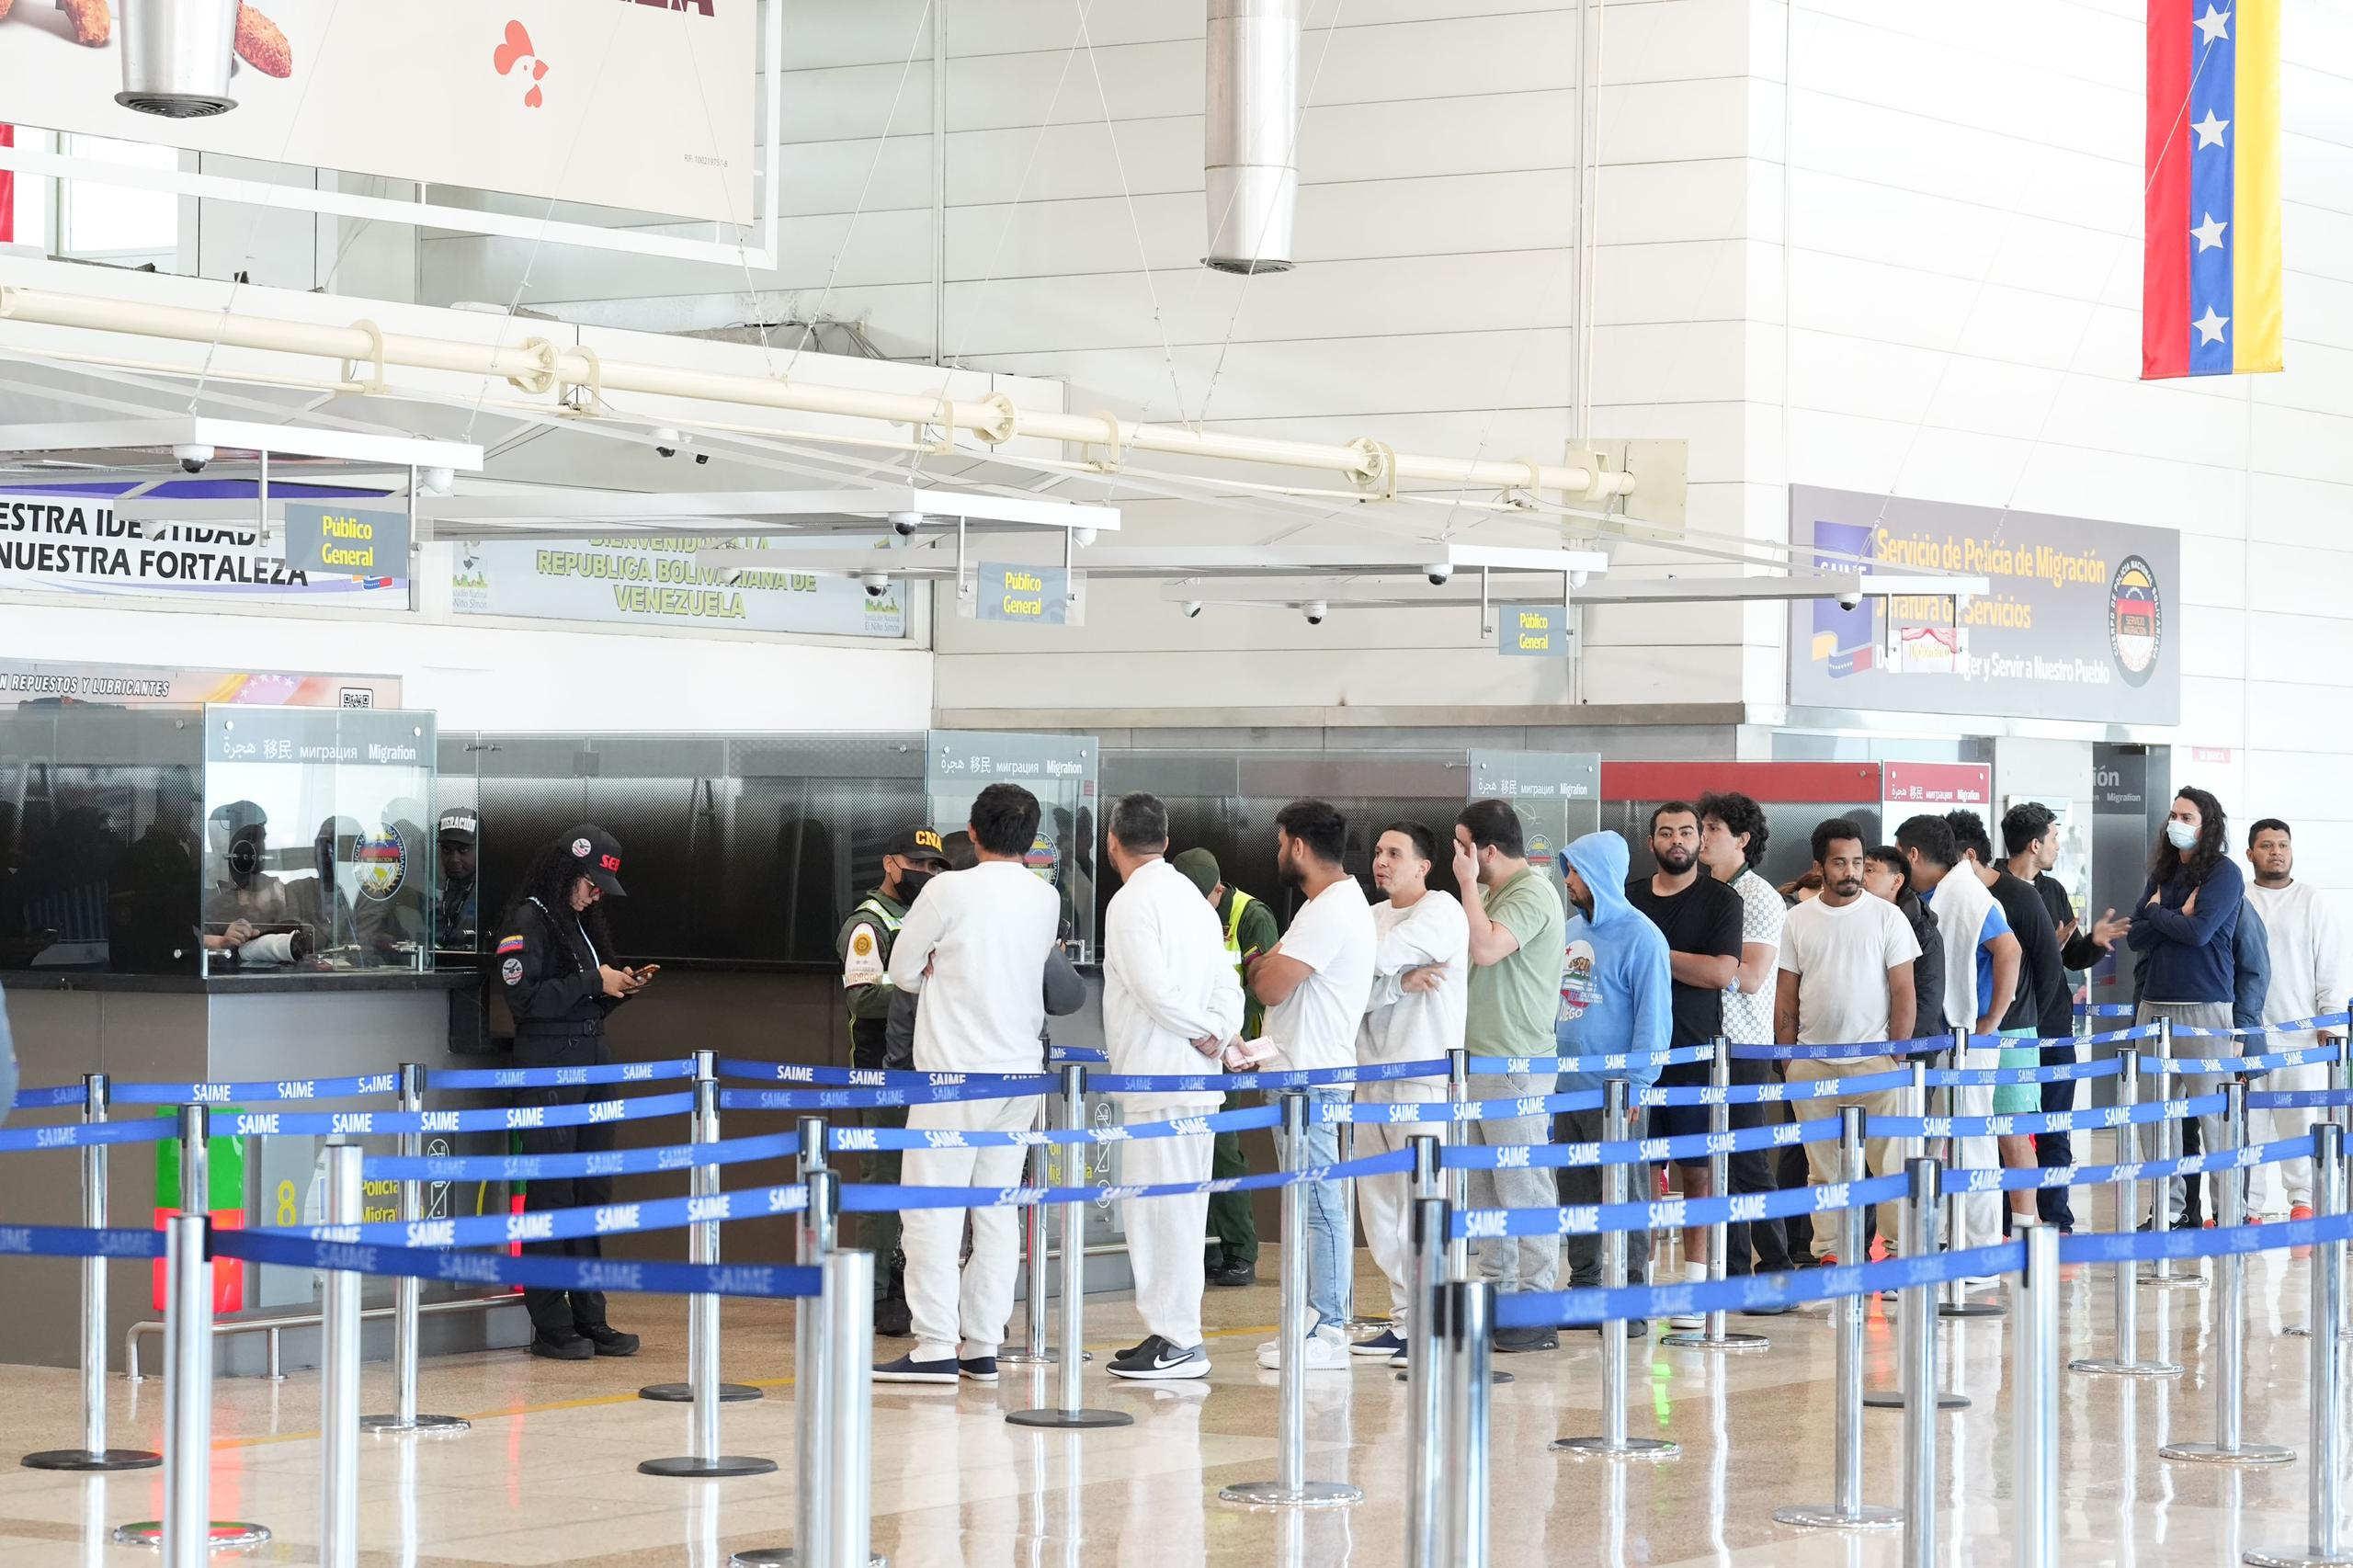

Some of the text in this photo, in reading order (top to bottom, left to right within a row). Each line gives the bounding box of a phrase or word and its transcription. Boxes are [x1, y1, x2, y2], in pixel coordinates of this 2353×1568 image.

[323, 515, 372, 540] Público
[322, 542, 373, 566] General
[1877, 528, 1939, 568] Servicio
[1942, 536, 1961, 571] de
[2015, 544, 2033, 577] de
[2036, 546, 2107, 588] Migración
[140, 550, 308, 586] FORTALEZA
[537, 550, 652, 582] REPUBLICA
[1005, 572, 1041, 591] Público
[614, 585, 745, 619] VENEZUELA
[1003, 595, 1041, 615] General
[1964, 596, 2031, 629] Servicios
[1519, 612, 1548, 629] Público
[1519, 632, 1549, 649] General
[1984, 656, 1992, 682] y
[1992, 652, 2024, 677] Servir
[2026, 660, 2033, 678] a
[2034, 655, 2074, 682] Nuestro
[2075, 658, 2110, 684] Pueblo
[11, 674, 77, 693] REPUESTOS
[83, 677, 90, 693] Y
[92, 678, 170, 697] LUBRICANTES
[369, 744, 416, 763] Migration
[1046, 760, 1083, 777] Migration
[1560, 782, 1587, 798] Migration
[1957, 789, 1980, 802] Migration
[2107, 793, 2141, 803] Migration
[915, 830, 943, 852] CNA
[2086, 1005, 2132, 1016] SAIME SAIME
[2145, 1023, 2160, 1036] SAIME
[1507, 1044, 1714, 1074] SAIME SAIME SAIME SAIME SAIME
[2160, 1051, 2305, 1073] SAIME SAIME
[556, 1069, 587, 1084] SAIME
[623, 1064, 653, 1079] SAIME
[777, 1065, 966, 1086] SAIME SAIME SAIME
[1232, 1068, 1357, 1089] SAIME SAIME SAIME
[1941, 1066, 2072, 1084] SAIME SAIME SAIME SAIME
[193, 1085, 231, 1102] SAIME
[278, 1081, 313, 1098] SAIME
[1639, 1078, 1839, 1106] SAIME SAIME SAIME SAIME
[237, 1100, 625, 1134] SAIME SAIME SAIME SAIME SAIME
[1322, 1096, 1545, 1122] SAIME SAIME SAIME SAIME
[1923, 1101, 2189, 1136] SAIME SAIME SAIME SAIME SAIME
[37, 1128, 76, 1147] SAIME
[837, 1129, 879, 1149] SAIME
[1169, 1117, 1212, 1136] SAIME
[1496, 1124, 1801, 1167] SAIME SAIME SAIME SAIME SAIME
[1968, 1169, 2006, 1192] SAIME
[2234, 1146, 2264, 1167] SAIME
[278, 1180, 296, 1226] 8
[1465, 1183, 1849, 1237] SAIME SAIME SAIME SAIME SAIME
[406, 1186, 809, 1248] SAIME SAIME SAIME SAIME SAIME
